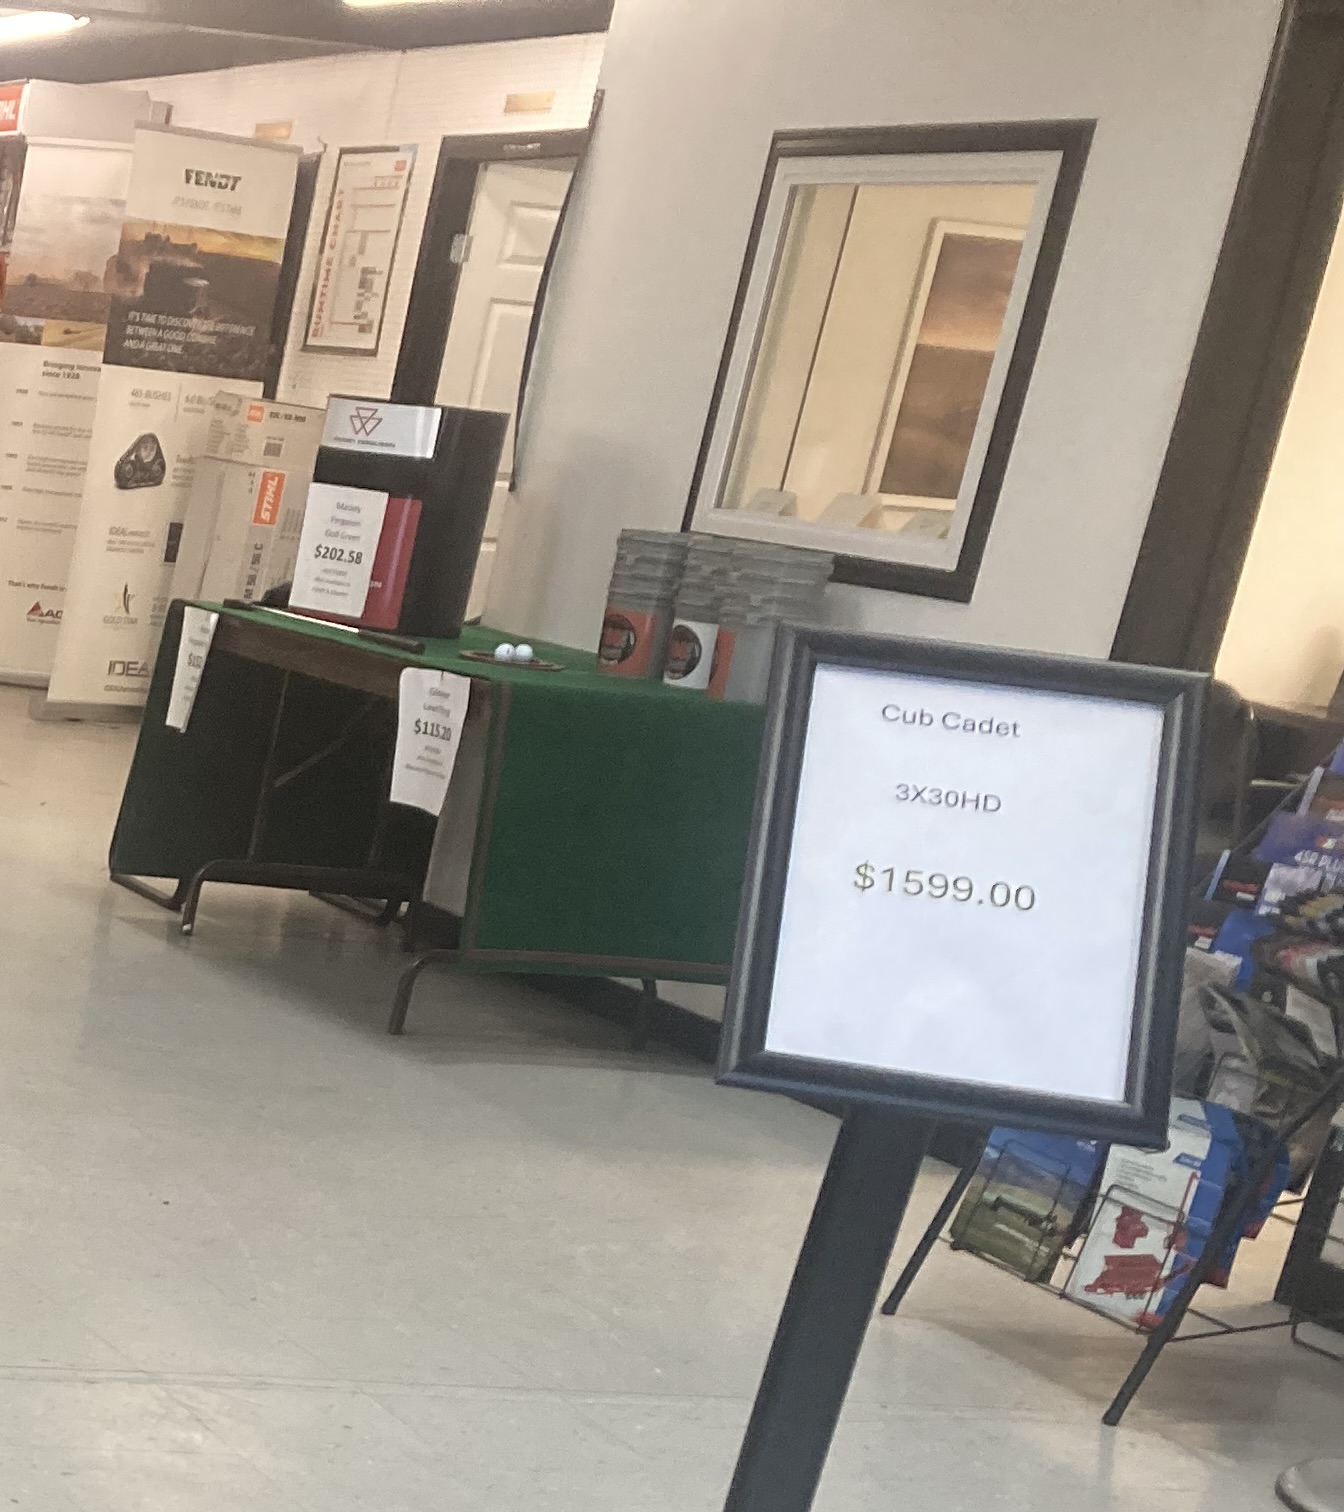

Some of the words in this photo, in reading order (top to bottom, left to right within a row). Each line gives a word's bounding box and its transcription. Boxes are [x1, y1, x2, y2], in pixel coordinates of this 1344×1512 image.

[184, 168, 242, 191] FENDT
[260, 476, 279, 524] STIHL
[314, 543, 363, 565] $202.58
[108, 659, 150, 677] IDEA
[881, 703, 935, 727] Cub
[942, 711, 1021, 738] Cadet
[895, 783, 1002, 813] 3X30HD
[853, 860, 1036, 911] $1599.00
